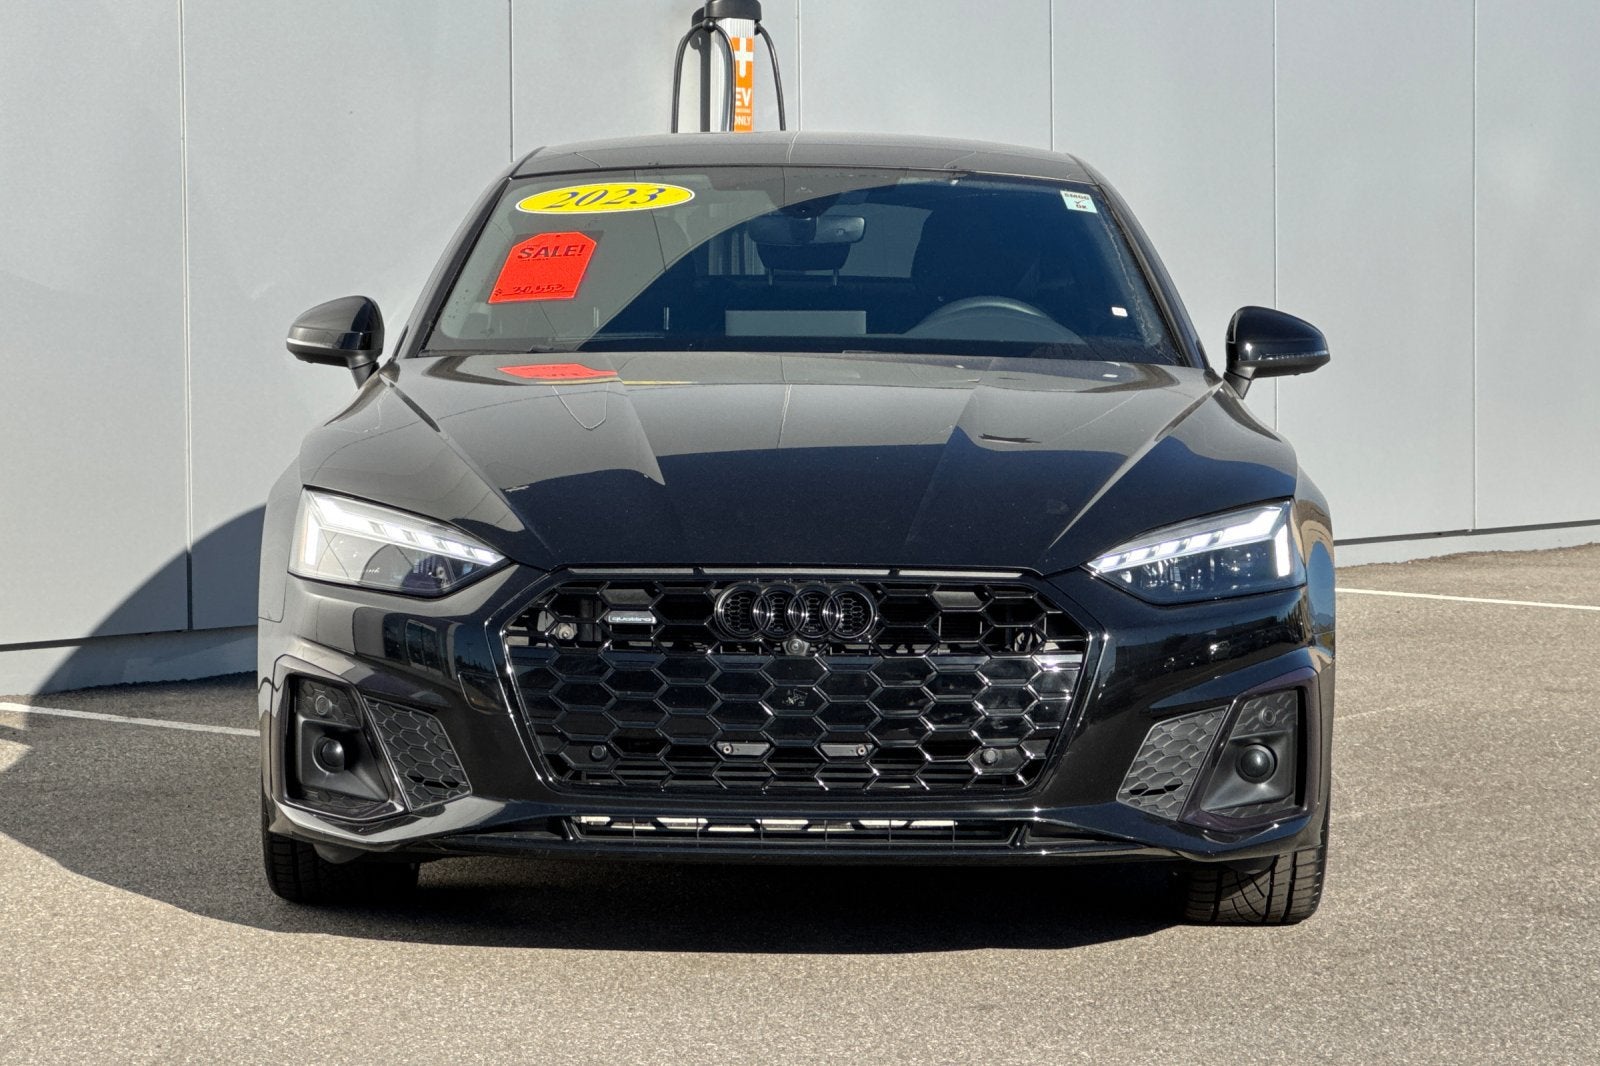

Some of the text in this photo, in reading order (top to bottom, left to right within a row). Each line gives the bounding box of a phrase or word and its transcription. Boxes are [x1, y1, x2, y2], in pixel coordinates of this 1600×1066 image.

[735, 87, 751, 106] EV
[543, 187, 666, 210] 2023
[517, 244, 586, 259] SALE!
